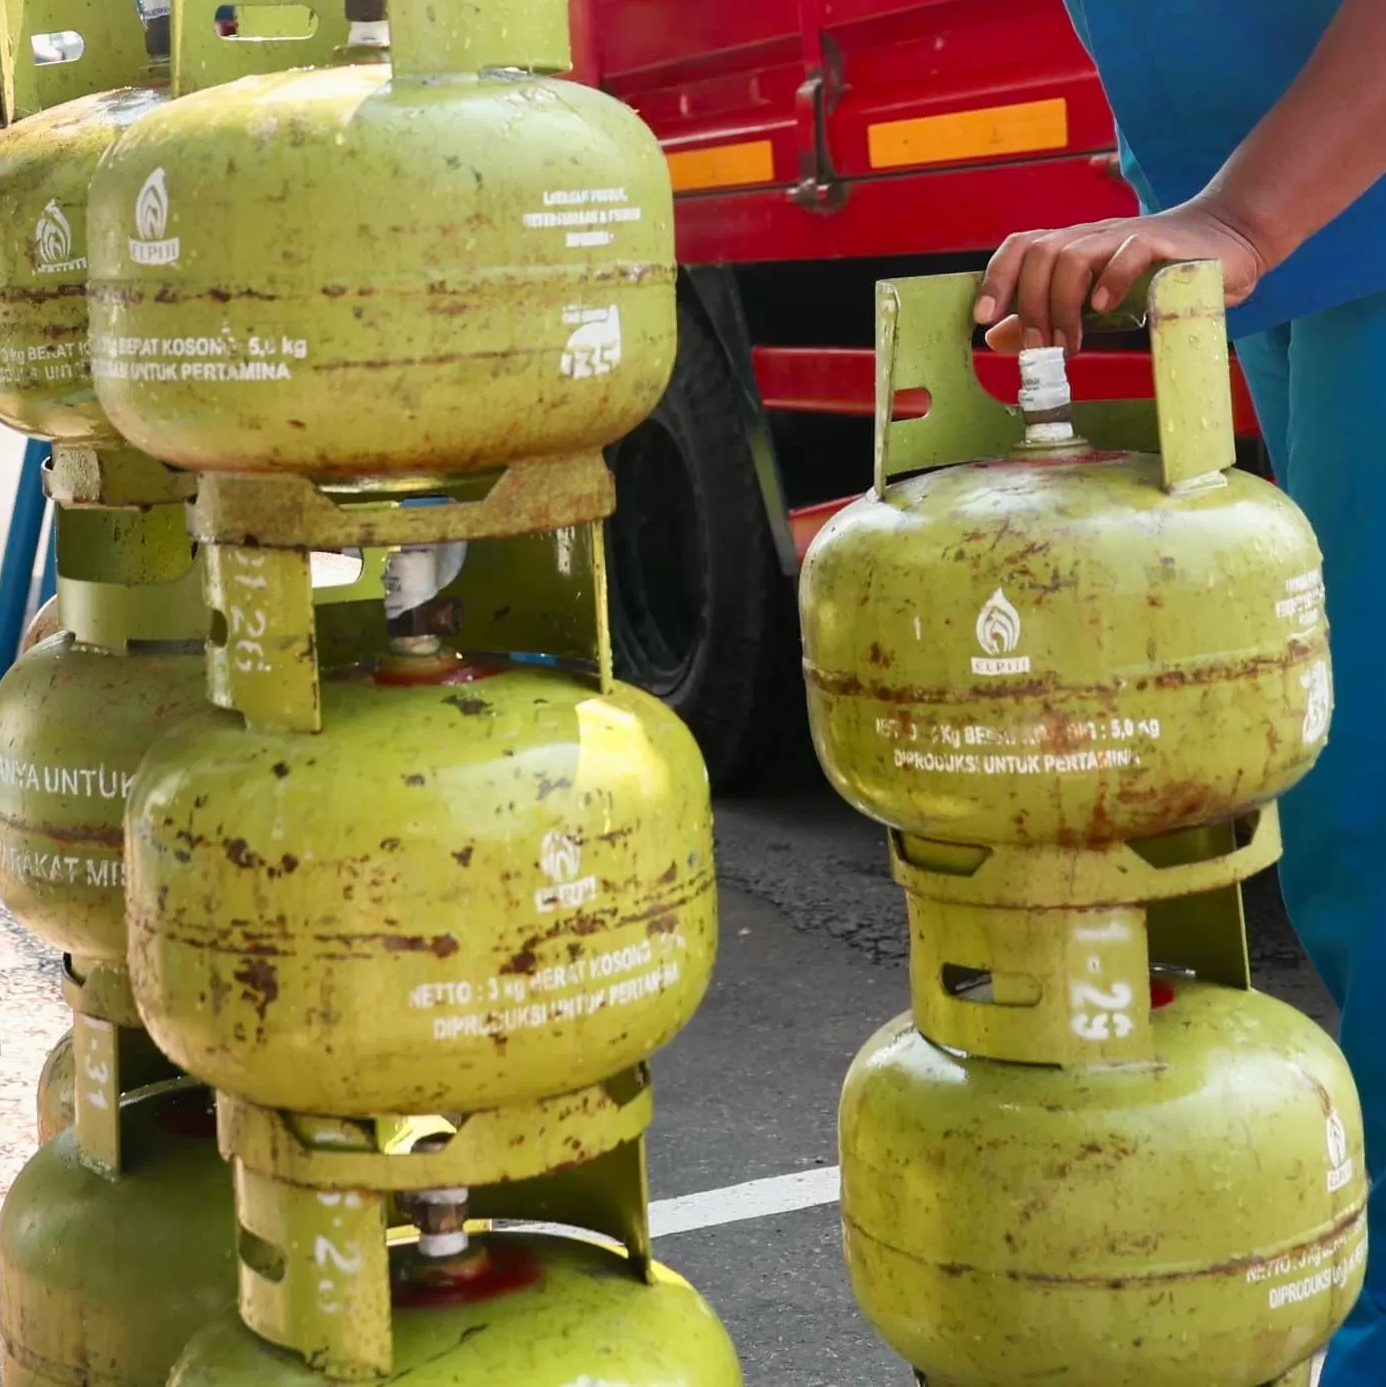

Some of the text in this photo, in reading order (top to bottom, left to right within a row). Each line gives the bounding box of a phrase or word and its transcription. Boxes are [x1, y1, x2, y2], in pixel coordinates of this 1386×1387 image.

[162, 336, 235, 357] KOSON
[282, 335, 308, 358] kg
[180, 361, 292, 382] PERTAMINA
[983, 753, 1041, 775] UNTUK
